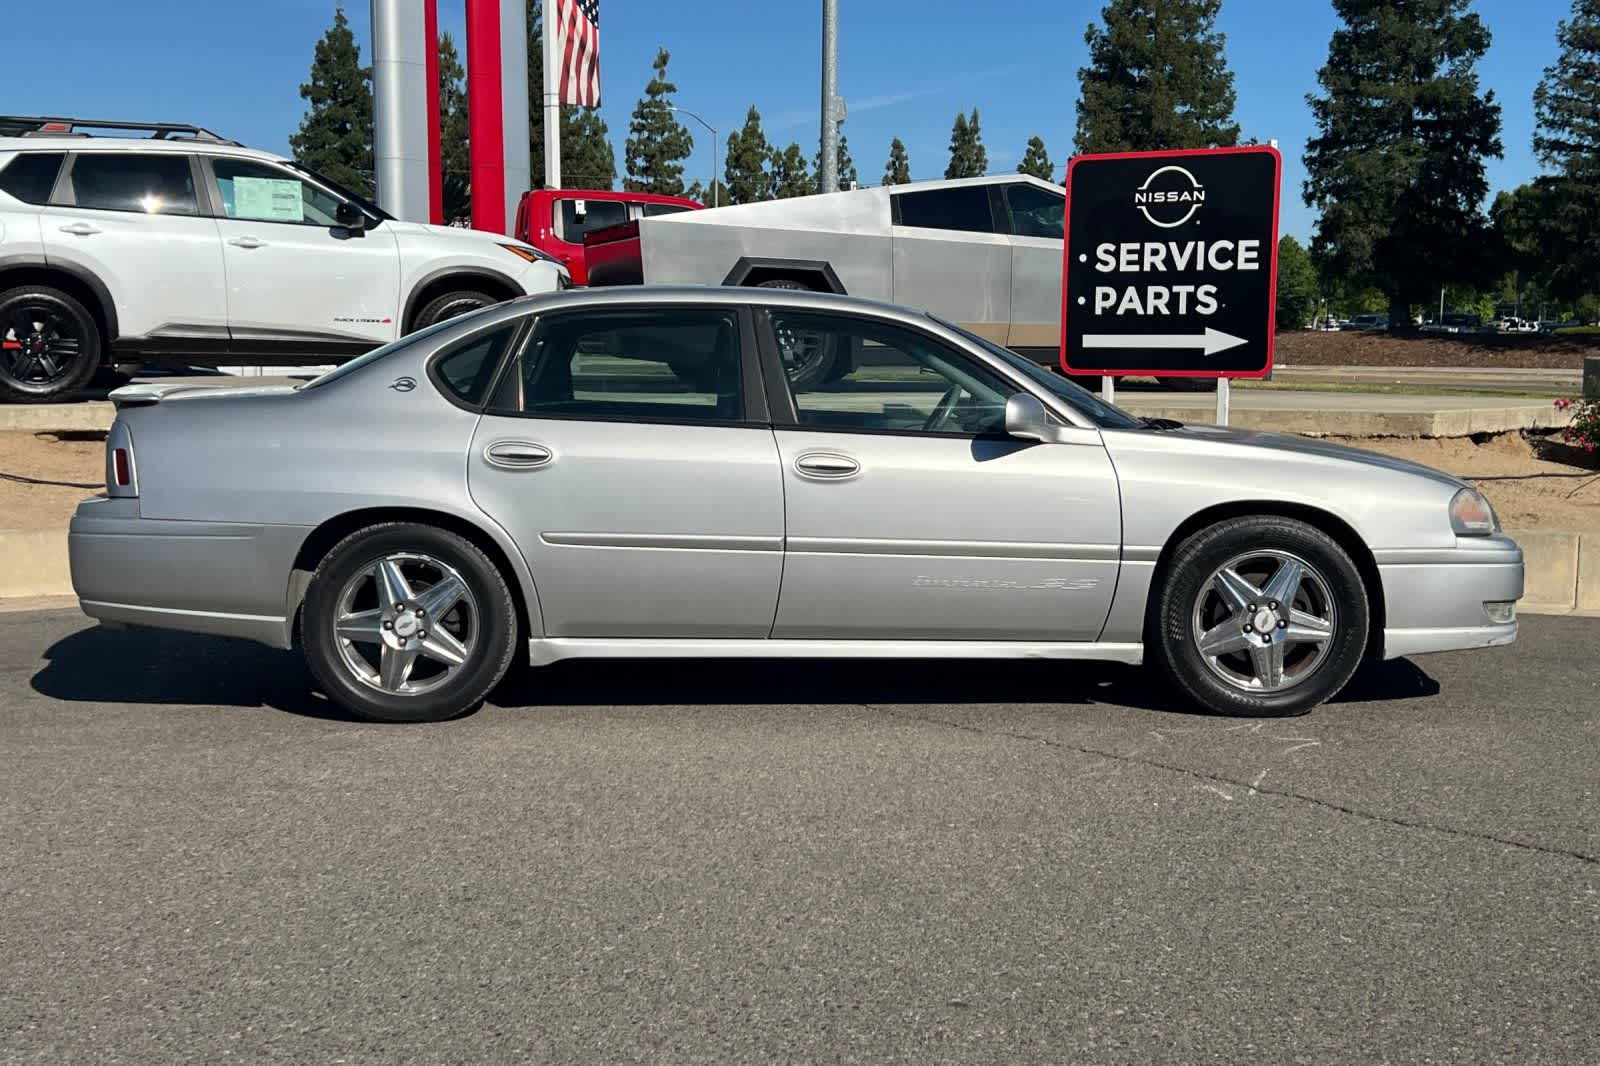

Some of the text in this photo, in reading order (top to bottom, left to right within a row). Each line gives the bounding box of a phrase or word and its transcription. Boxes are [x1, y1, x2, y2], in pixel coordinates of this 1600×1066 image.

[1135, 190, 1205, 203] NISSAN
[1095, 239, 1260, 272] SERVICE
[1094, 284, 1218, 316] PARTS
